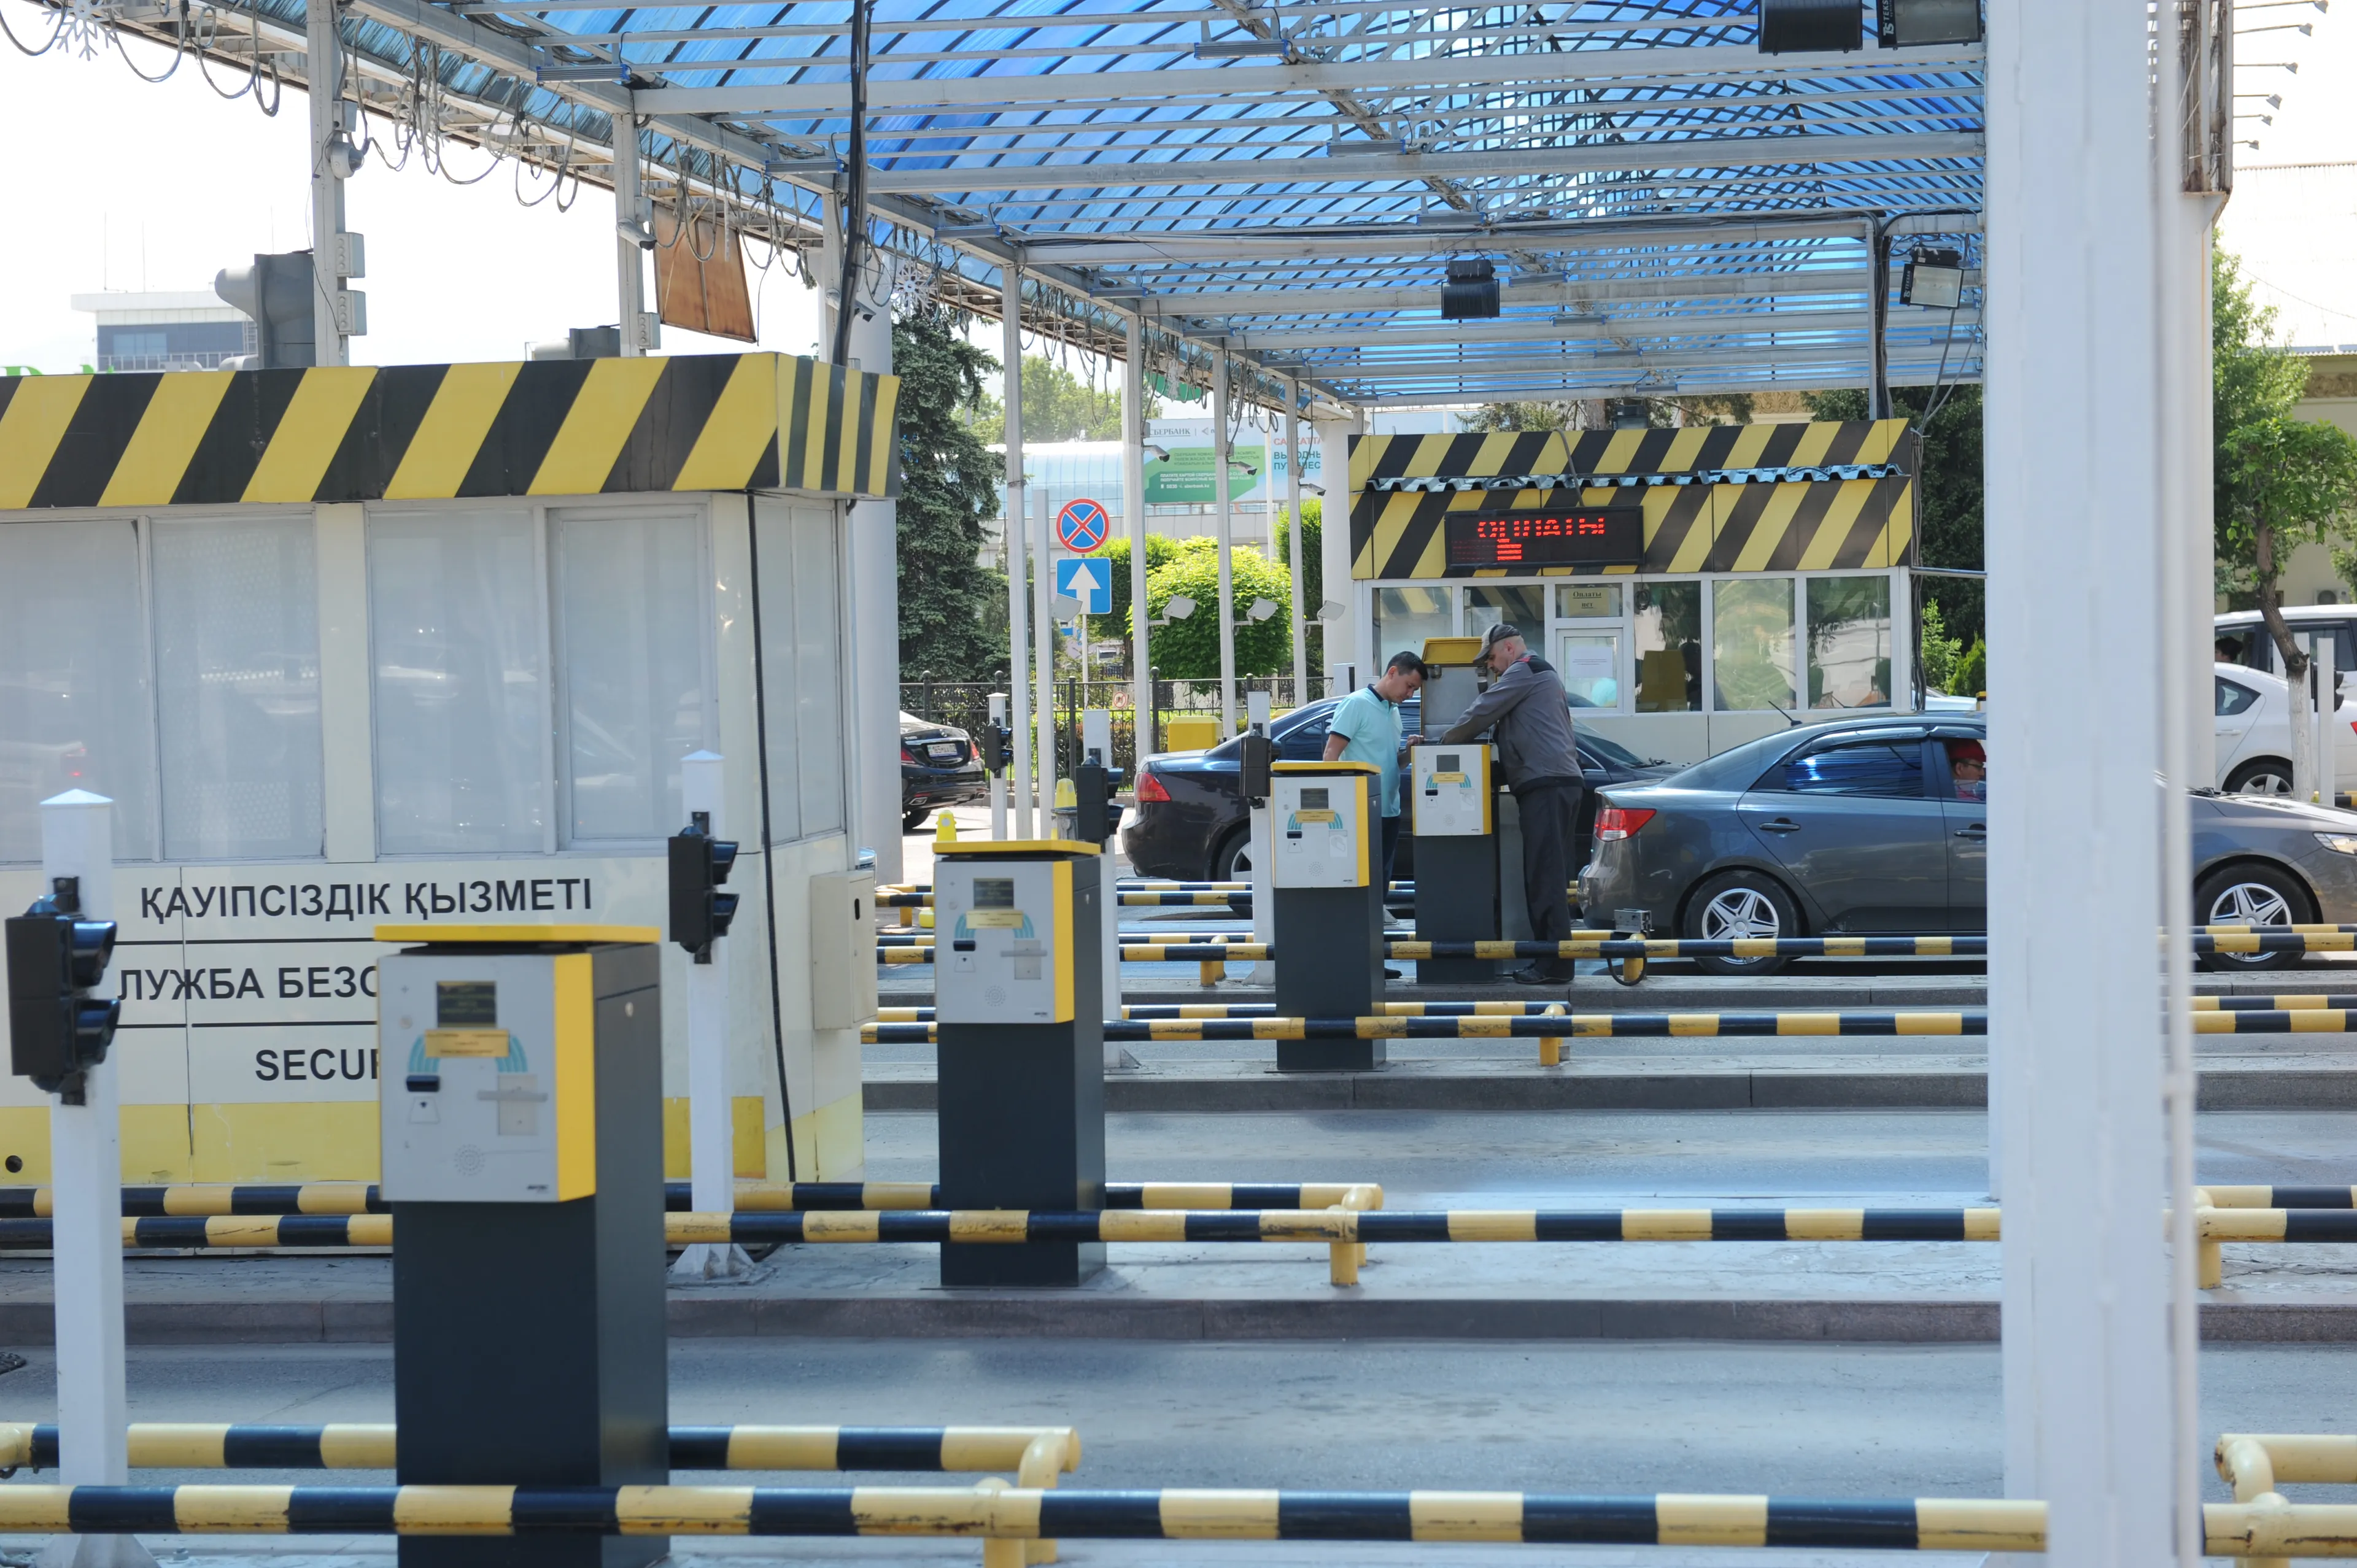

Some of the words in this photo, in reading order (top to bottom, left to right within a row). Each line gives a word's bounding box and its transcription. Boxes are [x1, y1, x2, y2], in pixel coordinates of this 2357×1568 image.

[141, 882, 391, 924] ҚАУІПСІЗДІК
[405, 878, 592, 921] ҚЫЗМЕТІ
[117, 968, 265, 1000] ЛУЖБА
[278, 965, 377, 999] БЕЗО
[255, 1048, 377, 1081] SECU
